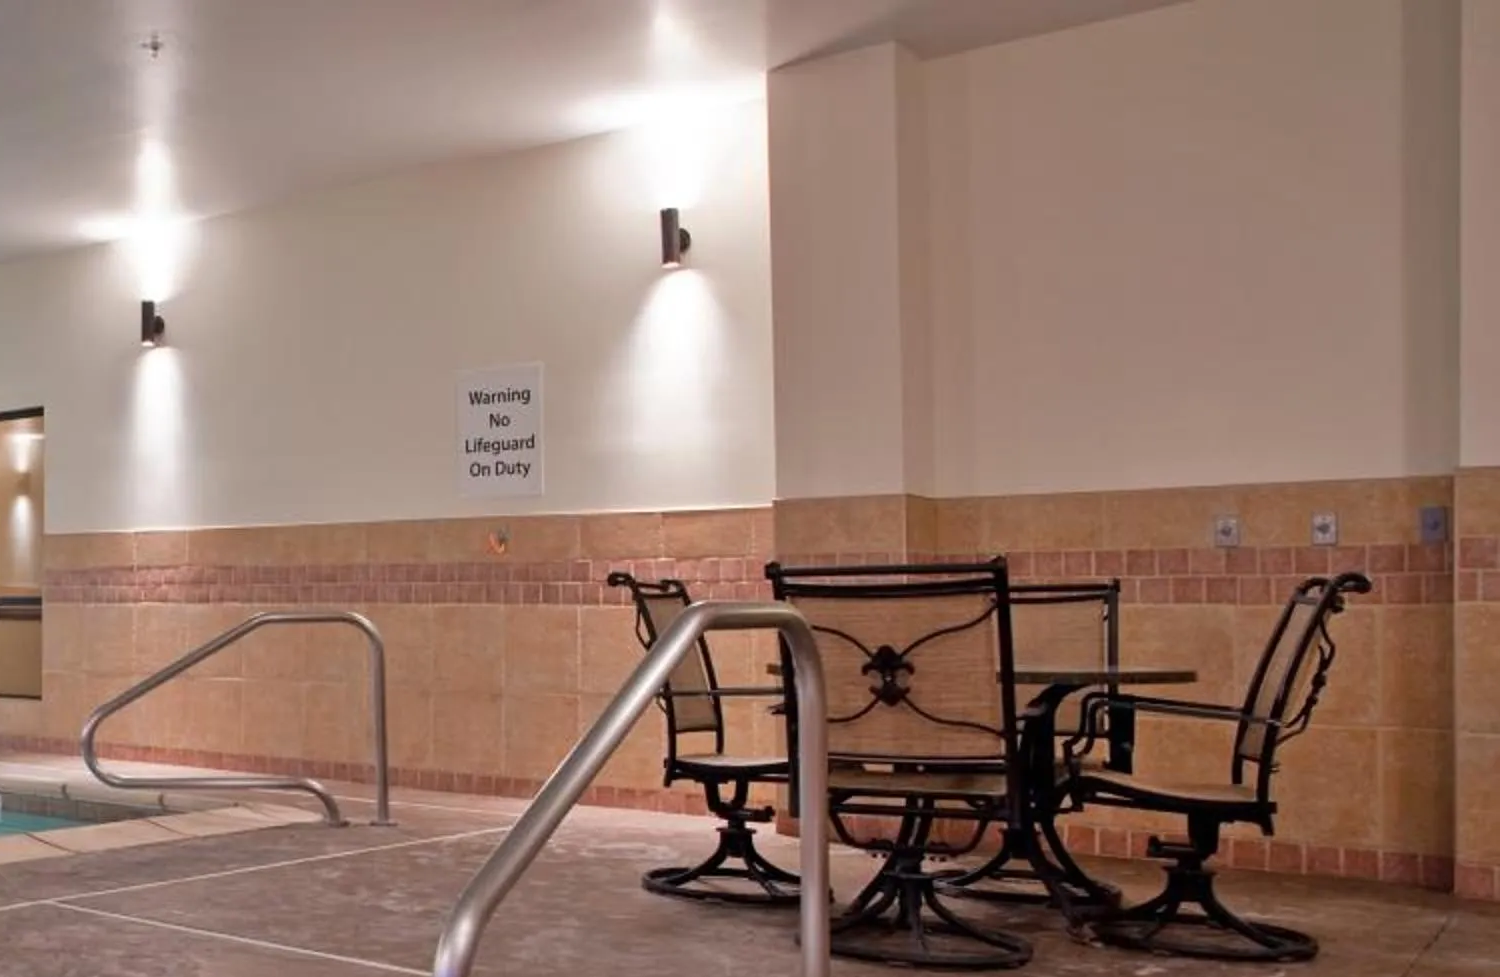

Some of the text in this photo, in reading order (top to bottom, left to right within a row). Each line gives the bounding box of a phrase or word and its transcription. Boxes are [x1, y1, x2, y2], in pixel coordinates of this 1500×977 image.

[468, 387, 531, 406] Warning
[489, 412, 511, 428] No
[465, 433, 535, 455] Lifeguard
[469, 460, 531, 478] On Duty
